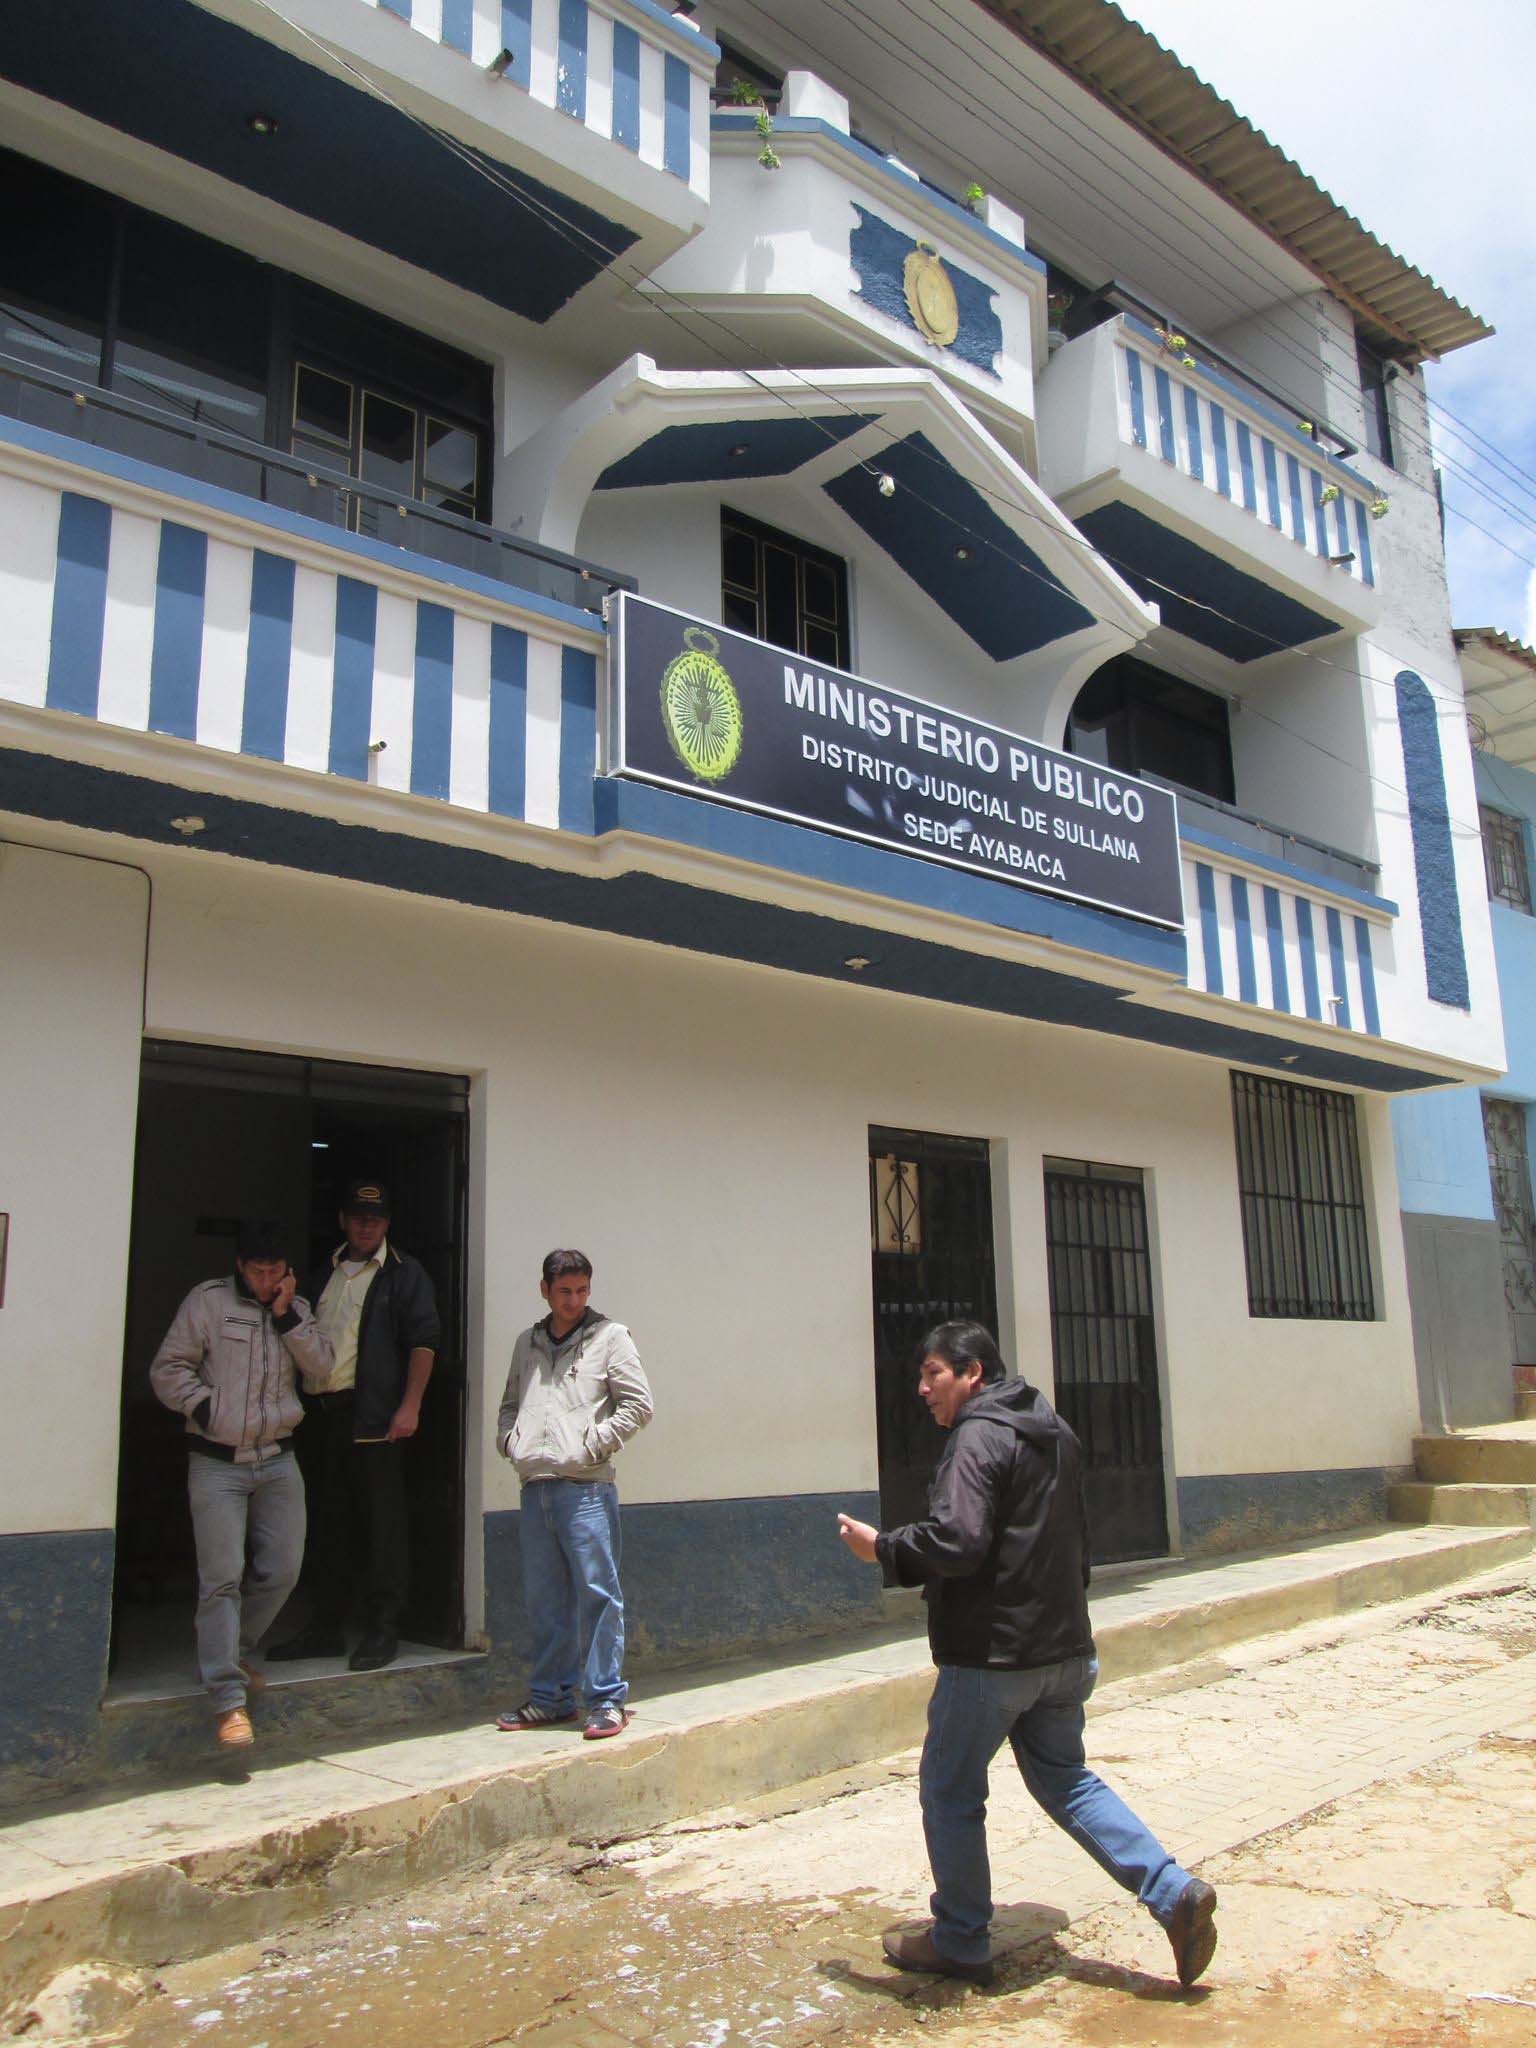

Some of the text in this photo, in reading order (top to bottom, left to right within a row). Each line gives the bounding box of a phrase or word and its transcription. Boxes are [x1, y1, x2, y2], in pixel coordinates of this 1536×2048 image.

[784, 666, 999, 774] MINISTERIO
[1010, 747, 1144, 823] PUBLICO
[802, 734, 1140, 864] DISTRITO JUDICIAL DE SULLANA
[903, 813, 1066, 881] SEDE AYABACA
